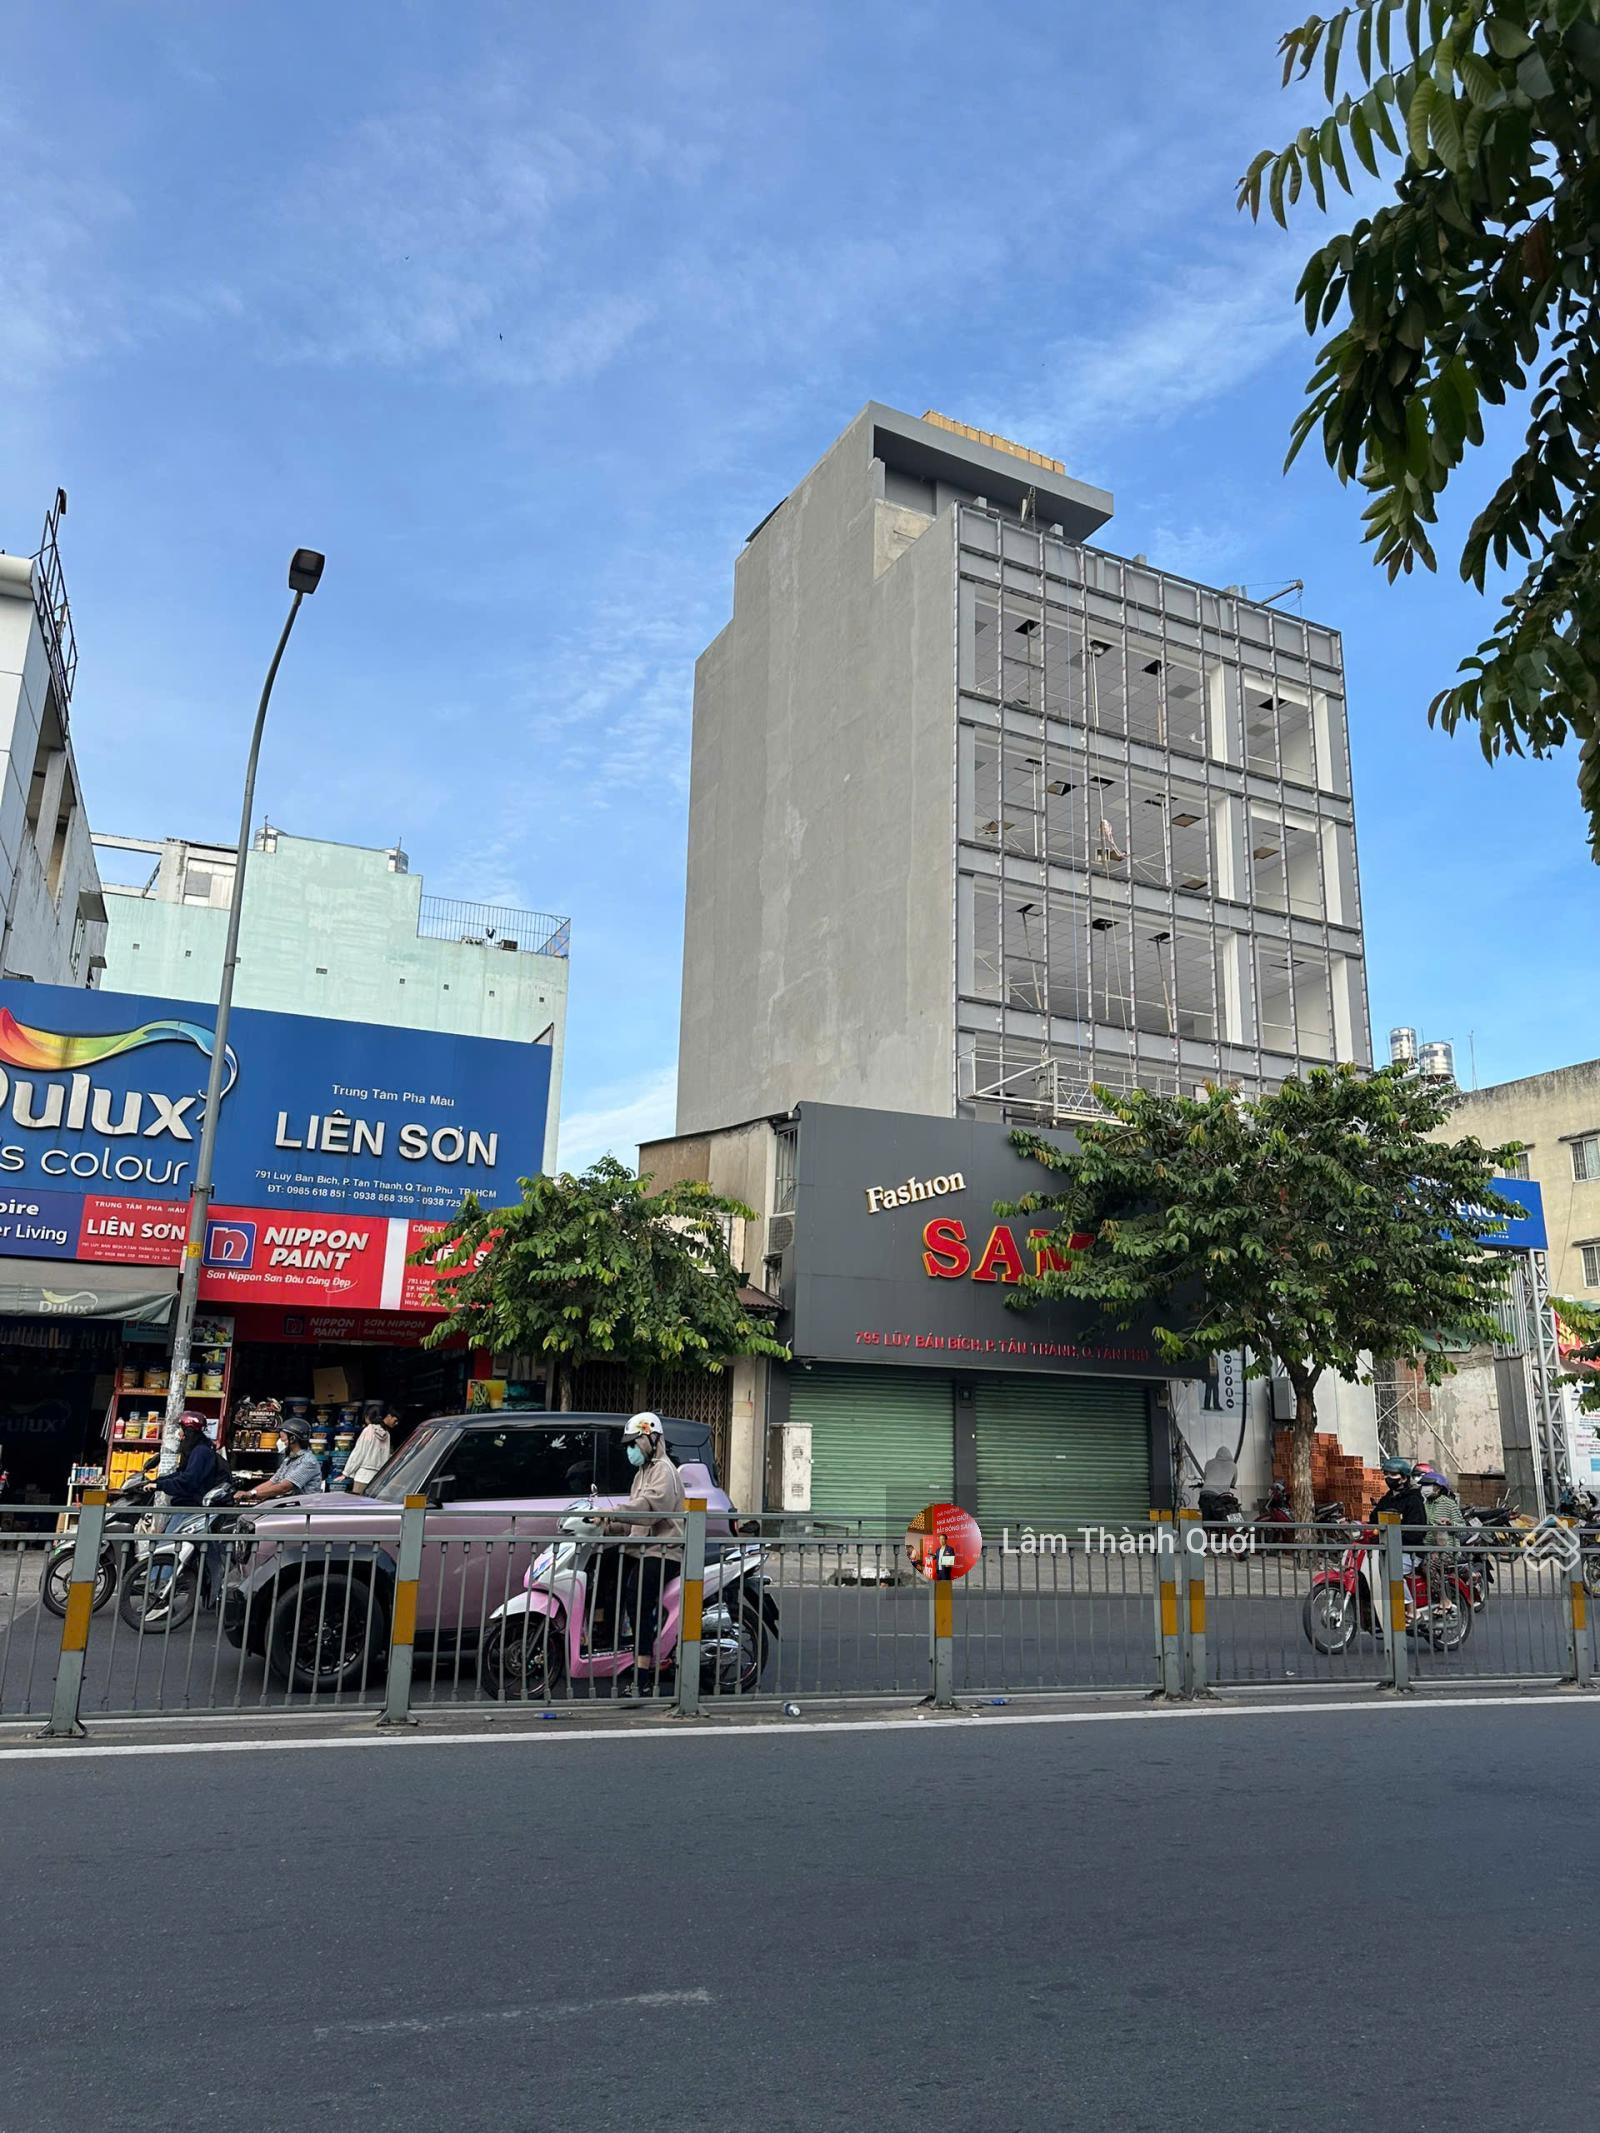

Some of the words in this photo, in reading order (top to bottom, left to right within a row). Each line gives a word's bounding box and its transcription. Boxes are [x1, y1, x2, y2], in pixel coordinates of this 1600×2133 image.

[0, 1067, 196, 1140] ulux
[332, 1084, 368, 1100] Trung
[402, 1091, 426, 1104] Pha
[274, 1109, 386, 1156] LIÊN
[398, 1123, 498, 1167] SƠN
[41, 1147, 190, 1185] colour
[255, 1169, 271, 1180] 791
[267, 1183, 285, 1194] ĐT:
[286, 1185, 310, 1196] 0985
[312, 1187, 328, 1198] 618
[329, 1188, 346, 1198] 851
[353, 1191, 376, 1201] 0938
[397, 1194, 415, 1204] 359
[422, 1196, 444, 1206] 0938
[445, 1198, 461, 1208] 725
[866, 1172, 966, 1214] Fashion
[95, 1201, 122, 1209] TRUNG
[16, 1223, 68, 1245] Living
[87, 1216, 135, 1237] LIÊN
[140, 1222, 186, 1241] SƠN
[263, 1226, 369, 1251] NIPPON
[269, 1247, 351, 1270] PAINT
[206, 1269, 226, 1279] Sơn
[227, 1271, 262, 1283] Nippon
[38, 1301, 90, 1315] Dulux
[309, 1317, 356, 1328] NIPPON
[313, 1327, 348, 1337] PAINT
[387, 1319, 426, 1329] NIPPON
[855, 1331, 880, 1345] 795
[915, 1331, 944, 1349] BÁN
[998, 1337, 1027, 1354] TÂN
